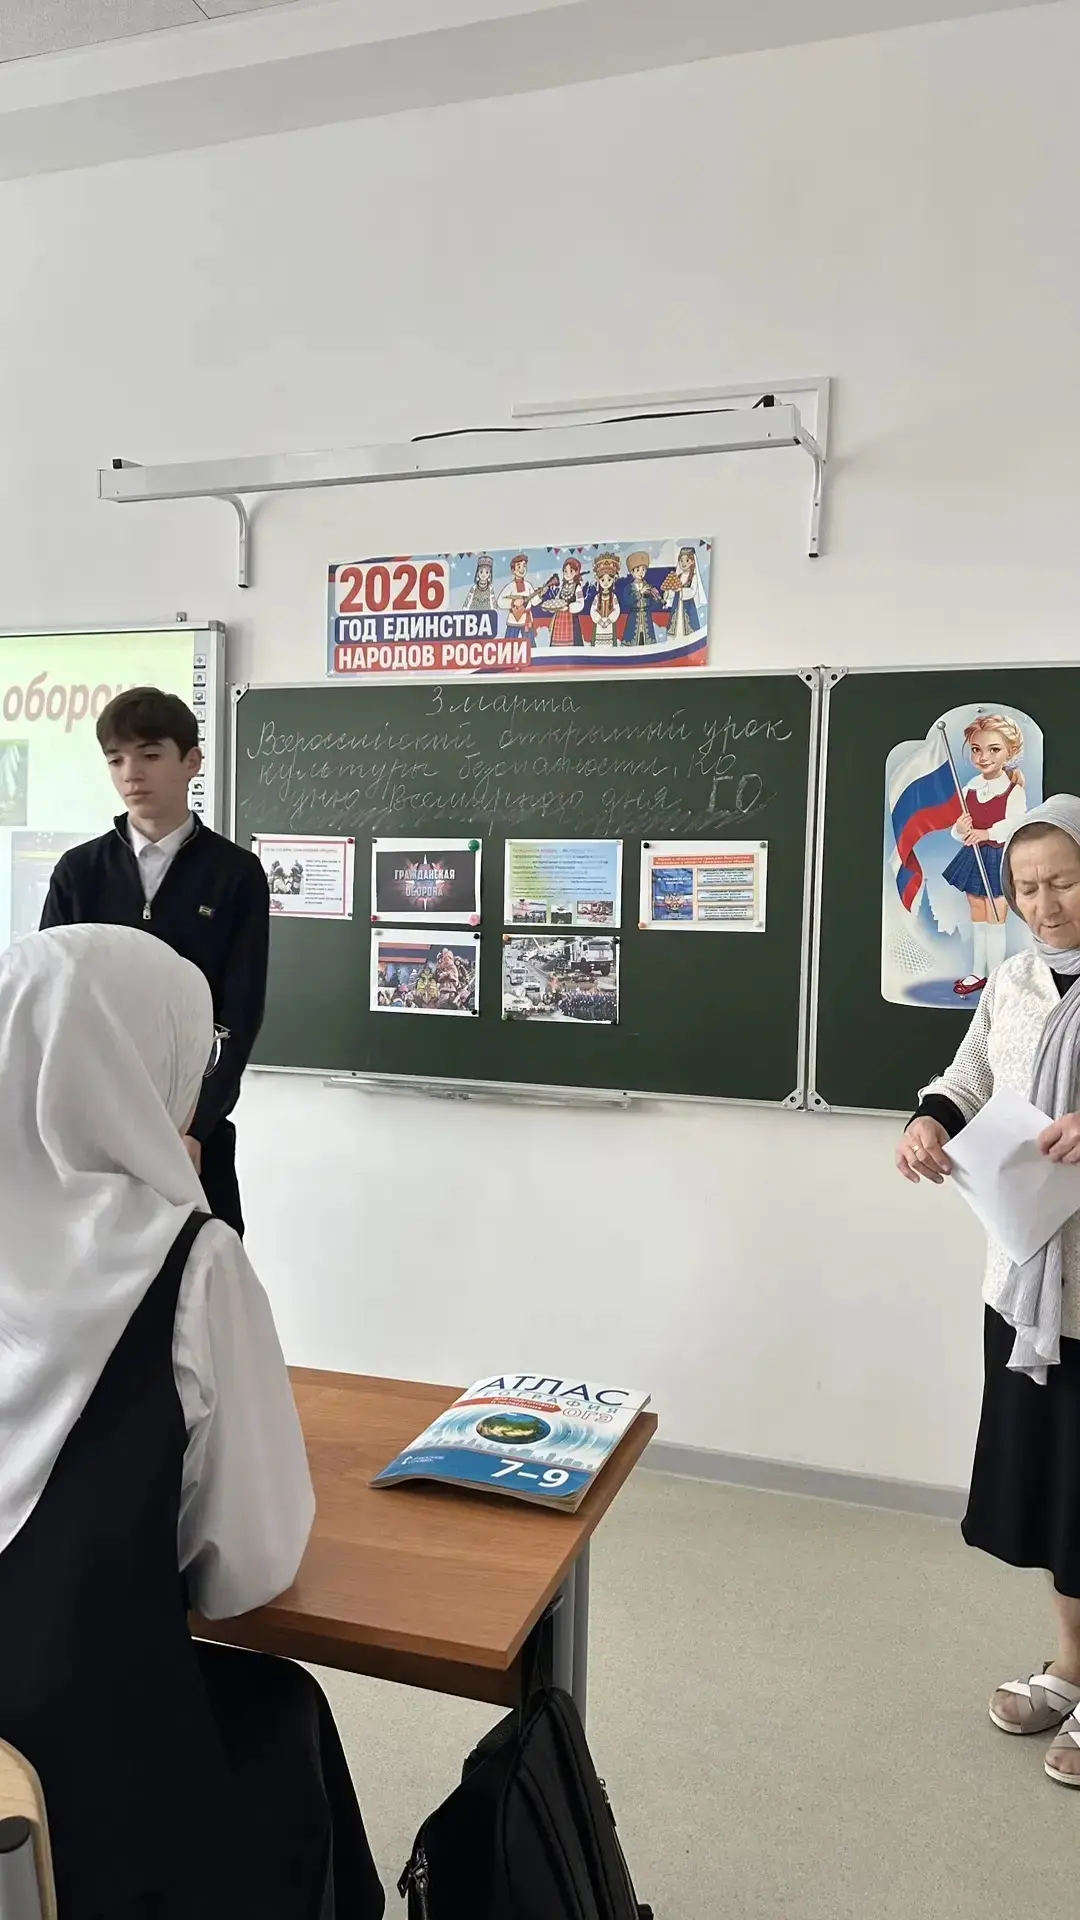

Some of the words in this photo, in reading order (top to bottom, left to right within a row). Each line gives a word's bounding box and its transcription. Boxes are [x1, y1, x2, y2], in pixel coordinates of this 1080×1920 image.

[339, 563, 446, 612] 2026
[338, 616, 379, 643] ГОД
[383, 614, 493, 642] ЕДИНСТВА
[338, 645, 436, 670] НАРОДОВ
[441, 643, 528, 667] РОССИИ
[3, 671, 156, 733] оборо
[425, 686, 443, 716] 3
[449, 695, 581, 728] марта
[699, 715, 792, 754] урок
[707, 774, 764, 813] ГО
[394, 869, 456, 880] ГРАЖДАНСКАЯ
[405, 887, 444, 897] ОБОРОНА
[477, 1376, 629, 1406] АТЛАС
[562, 1408, 613, 1424] ОГЭ
